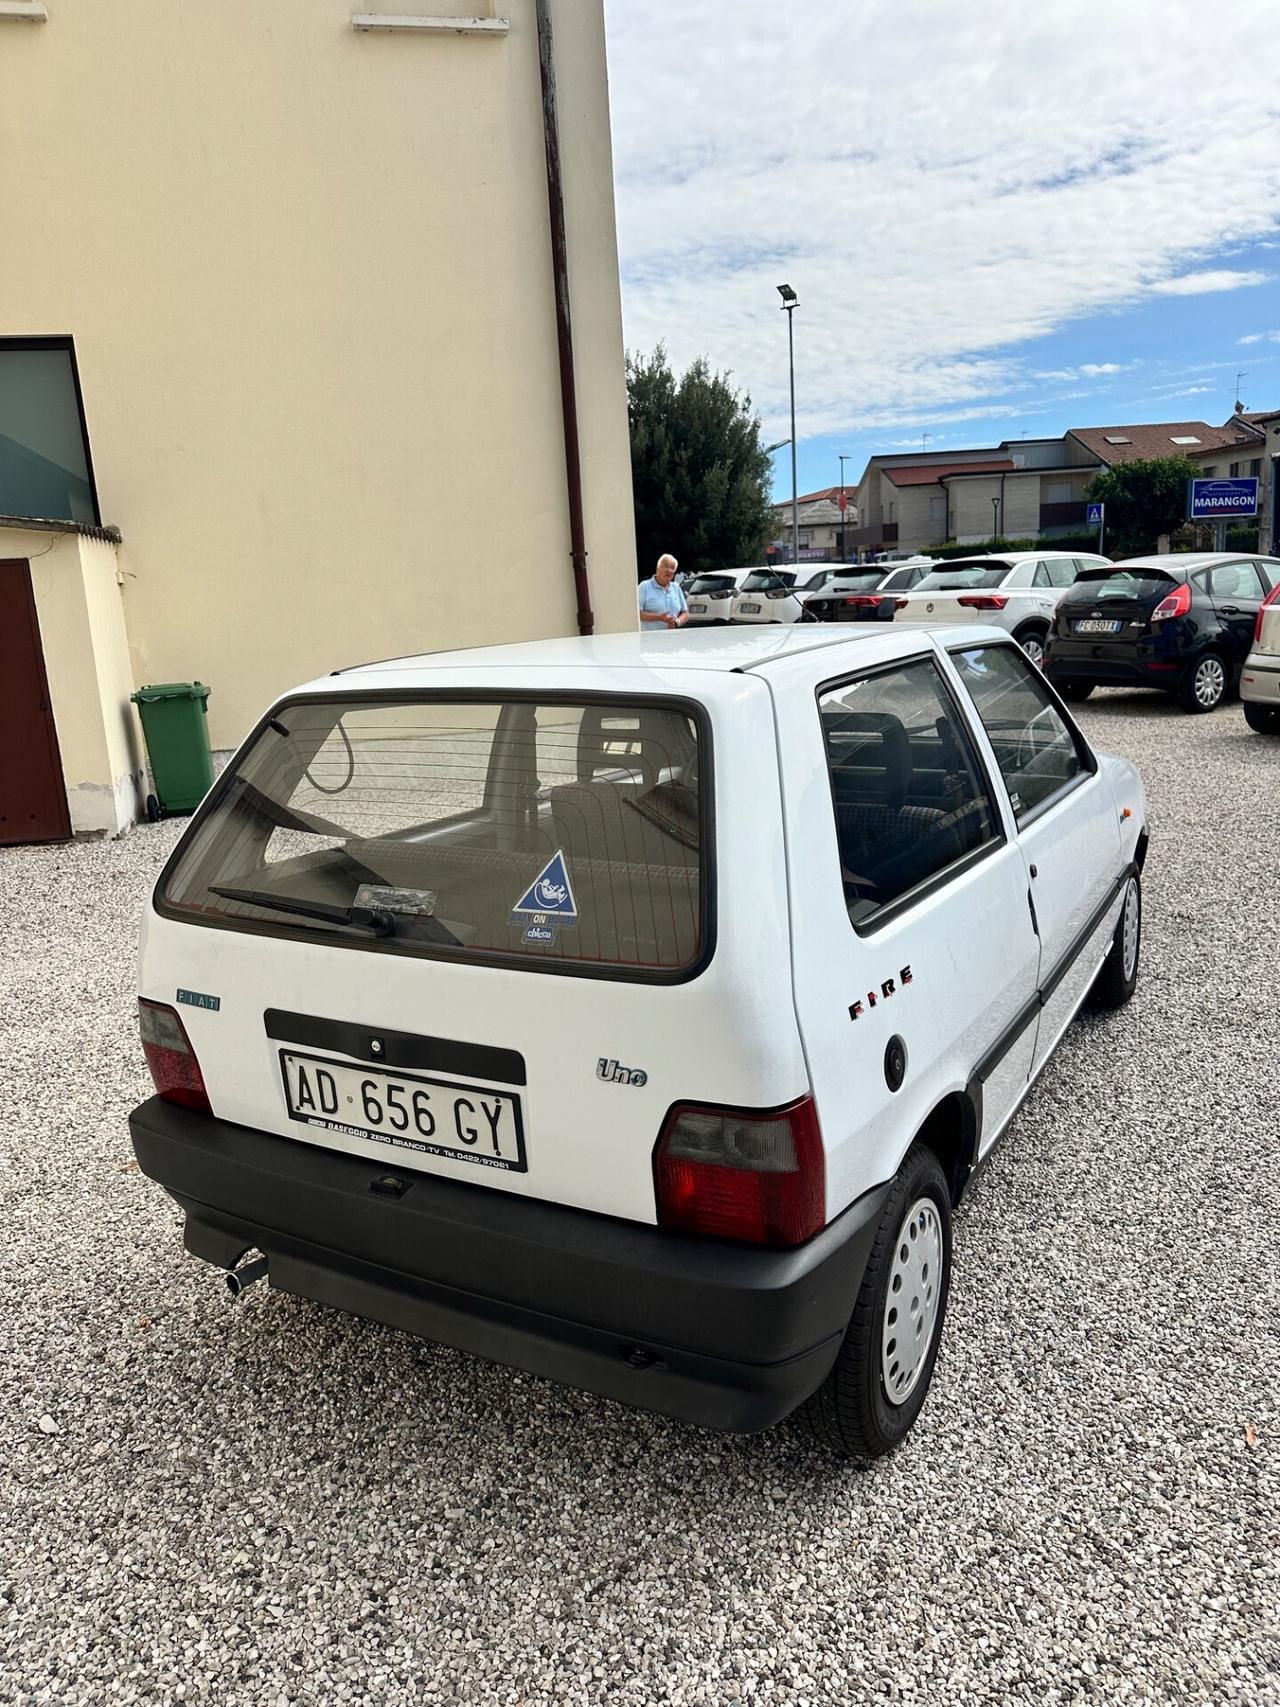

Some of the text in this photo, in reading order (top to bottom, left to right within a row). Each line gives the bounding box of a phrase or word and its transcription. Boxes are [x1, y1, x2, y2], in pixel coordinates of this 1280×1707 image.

[1194, 496, 1255, 507] MARANGON
[533, 914, 546, 924] ON
[179, 991, 216, 1009] FIAT
[848, 964, 913, 1021] FIRE
[596, 1057, 648, 1087] Uno
[299, 1065, 502, 1151] AD 656 GY
[327, 1122, 368, 1139] BASEGGIO
[370, 1133, 391, 1143] ZERO
